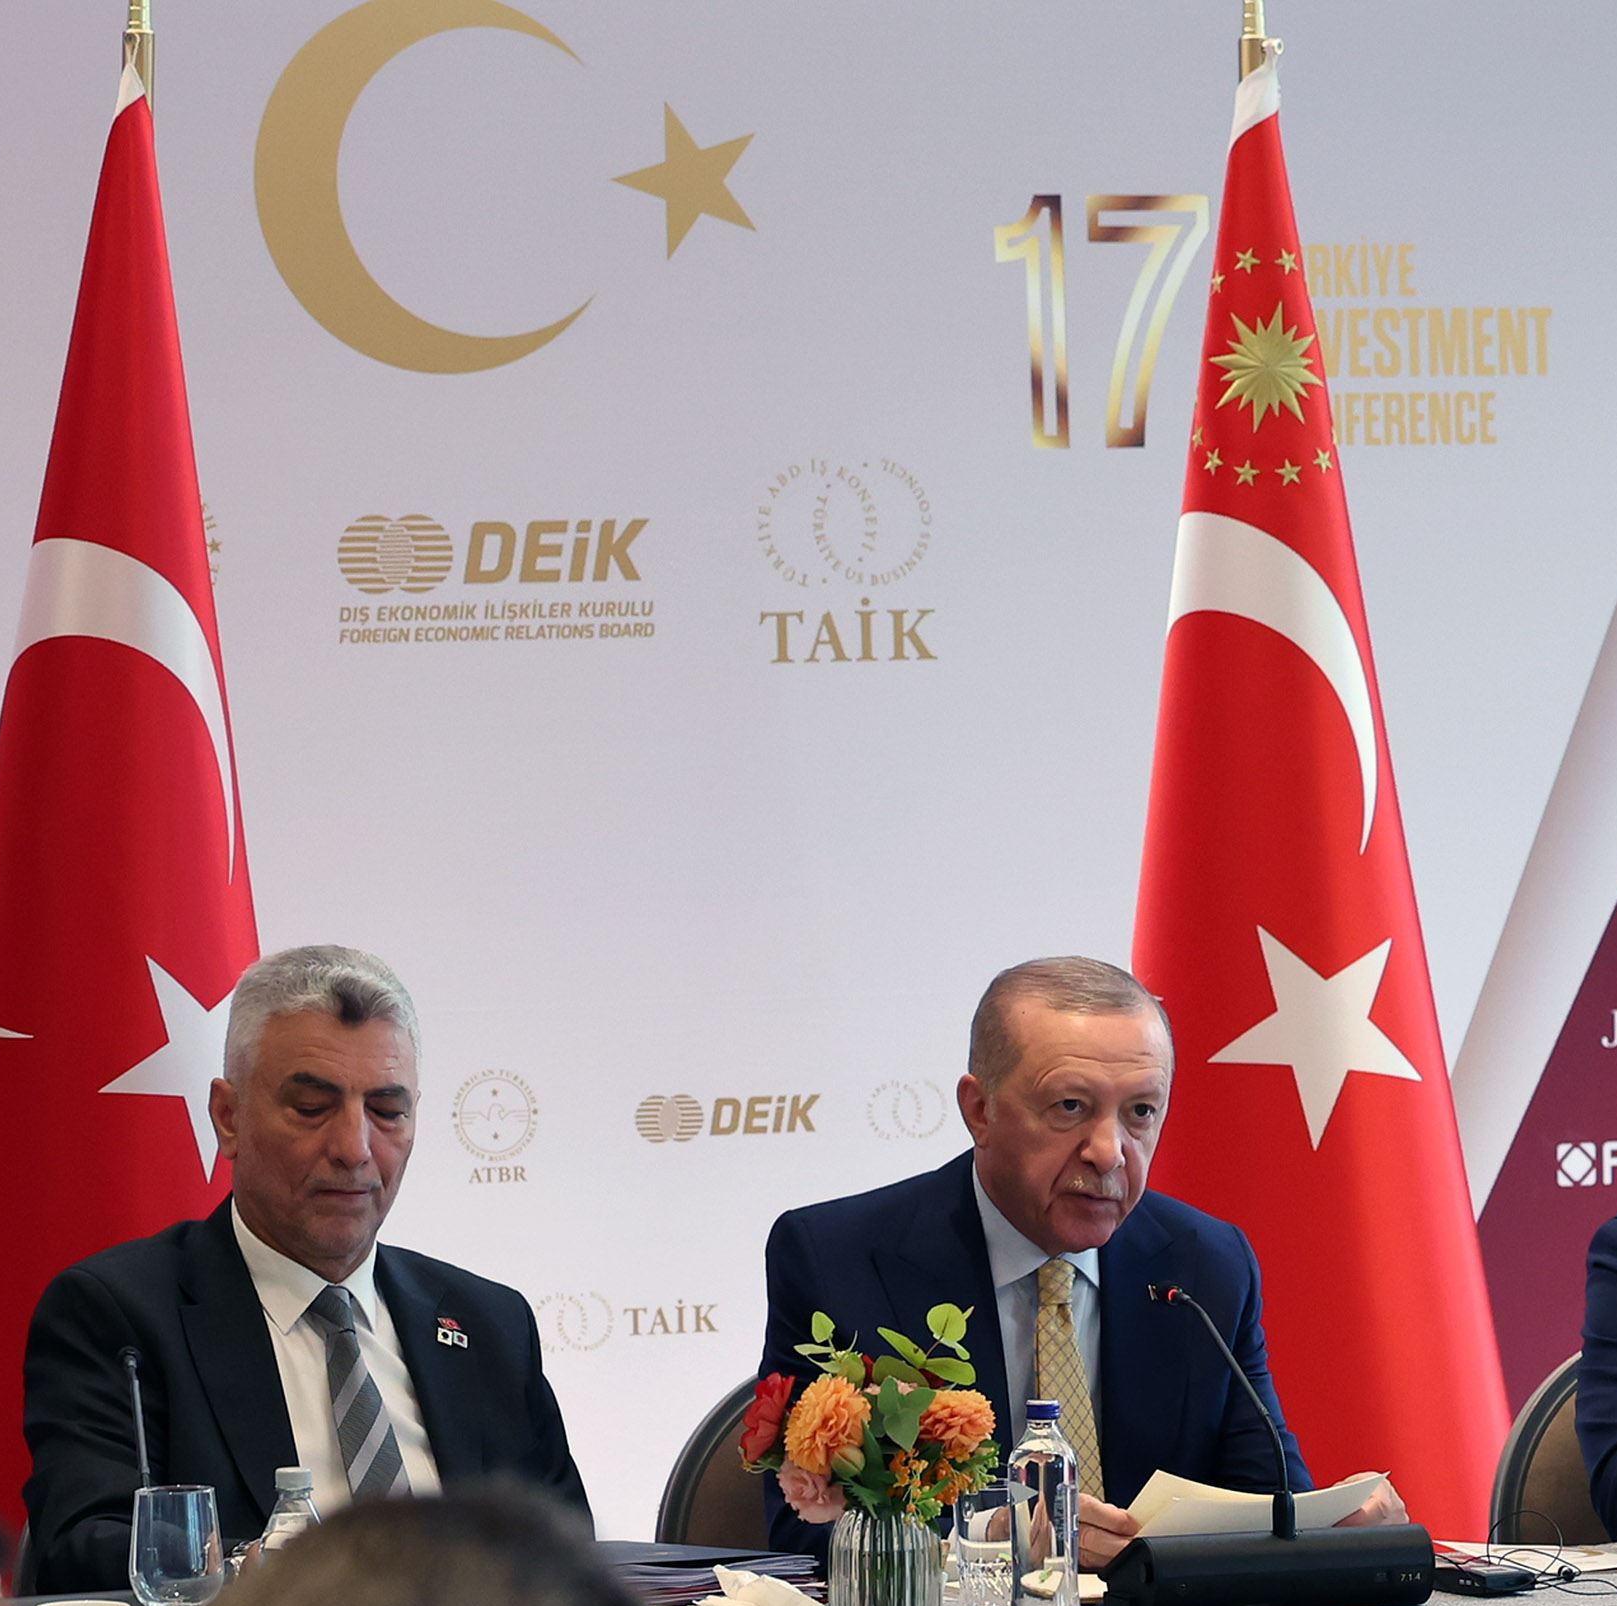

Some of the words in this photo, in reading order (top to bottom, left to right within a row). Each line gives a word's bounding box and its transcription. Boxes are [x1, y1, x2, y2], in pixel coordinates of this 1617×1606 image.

[1305, 234, 1417, 298] RKİYE
[994, 194, 1211, 448] 17
[1316, 306, 1552, 379] VESTMENT
[1336, 391, 1497, 446] FERENCE
[339, 627, 410, 644] FOREIGN
[414, 625, 500, 642] ECONOMIC
[505, 623, 595, 641] RELATIONS
[599, 622, 655, 639] BOARD
[376, 600, 477, 623] EKONOMİK
[578, 600, 655, 618] KURULU
[759, 597, 938, 664] TAİK
[469, 1165, 527, 1184] ATBR
[623, 1299, 719, 1336] TAİK
